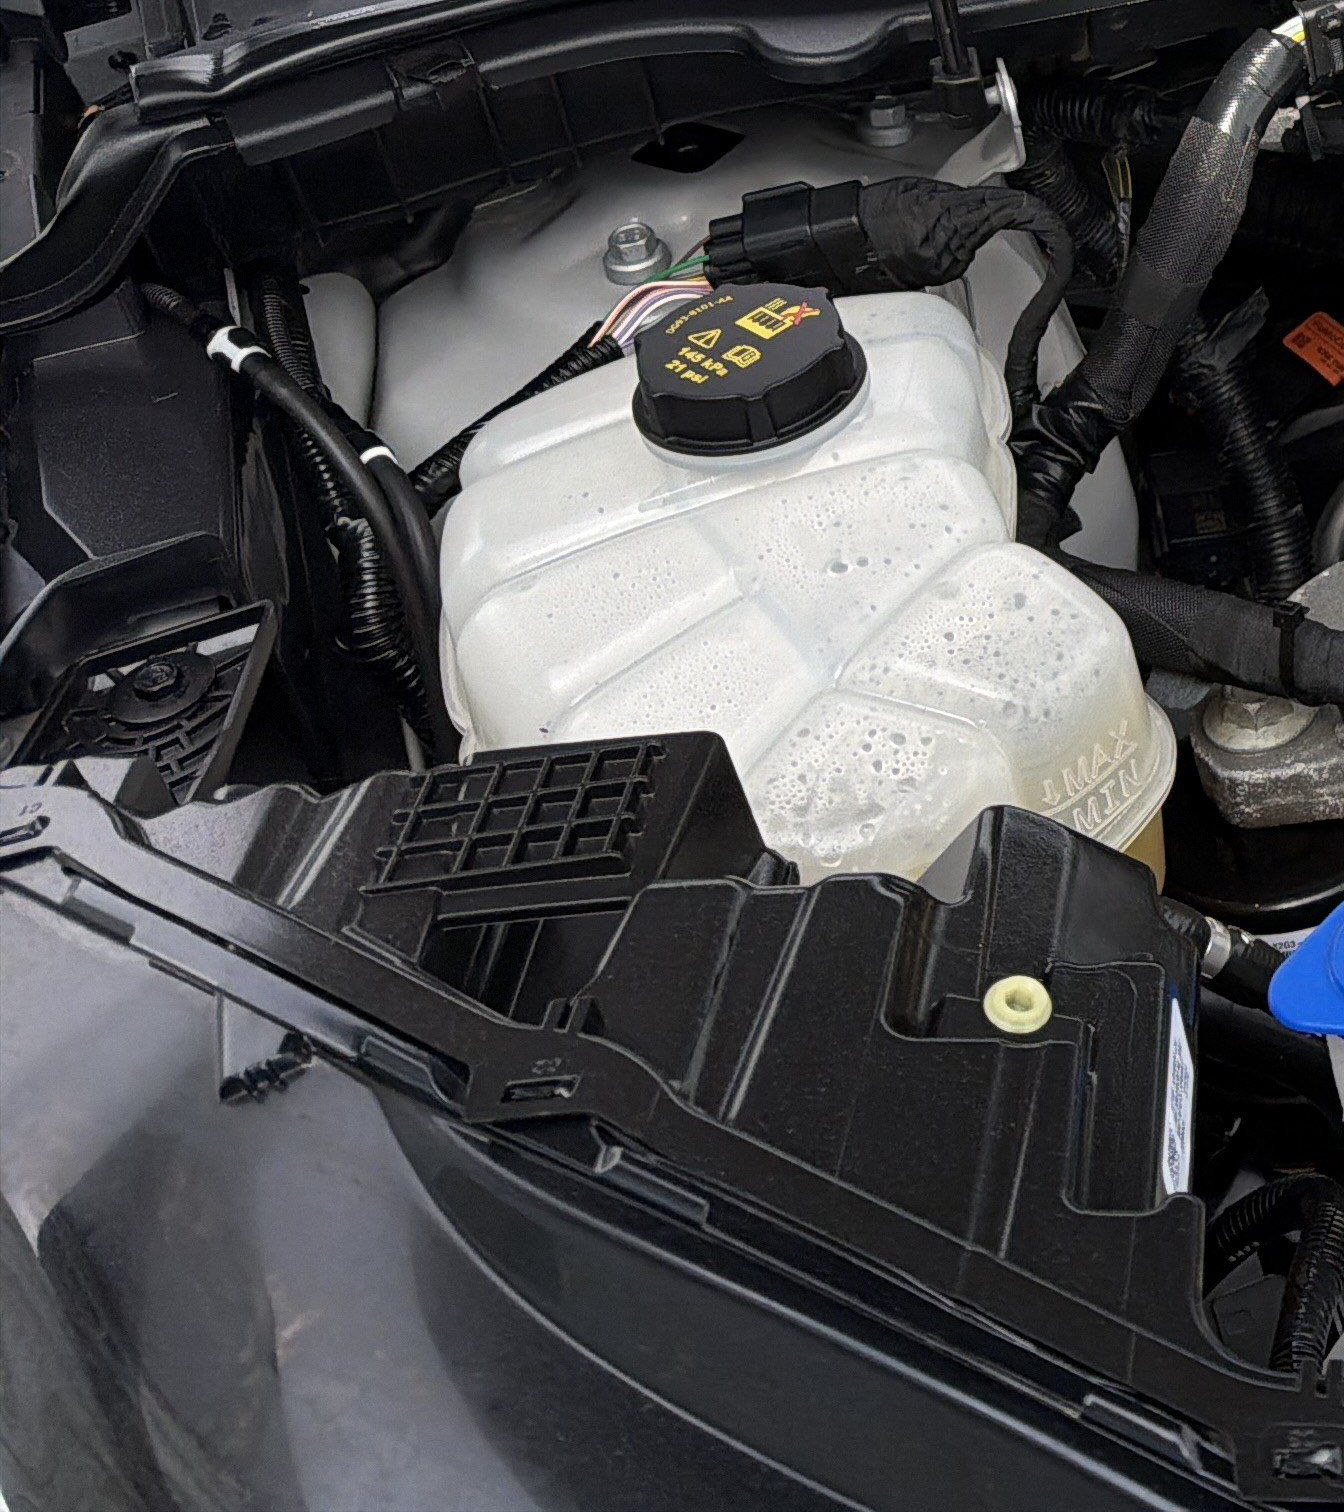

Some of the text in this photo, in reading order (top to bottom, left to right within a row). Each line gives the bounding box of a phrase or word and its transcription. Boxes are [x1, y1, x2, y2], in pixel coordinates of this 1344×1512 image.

[664, 359, 709, 384] 21 psi
[678, 347, 729, 377] 145 kPa
[1062, 720, 1134, 797] MAX
[1073, 759, 1139, 834] MIN
